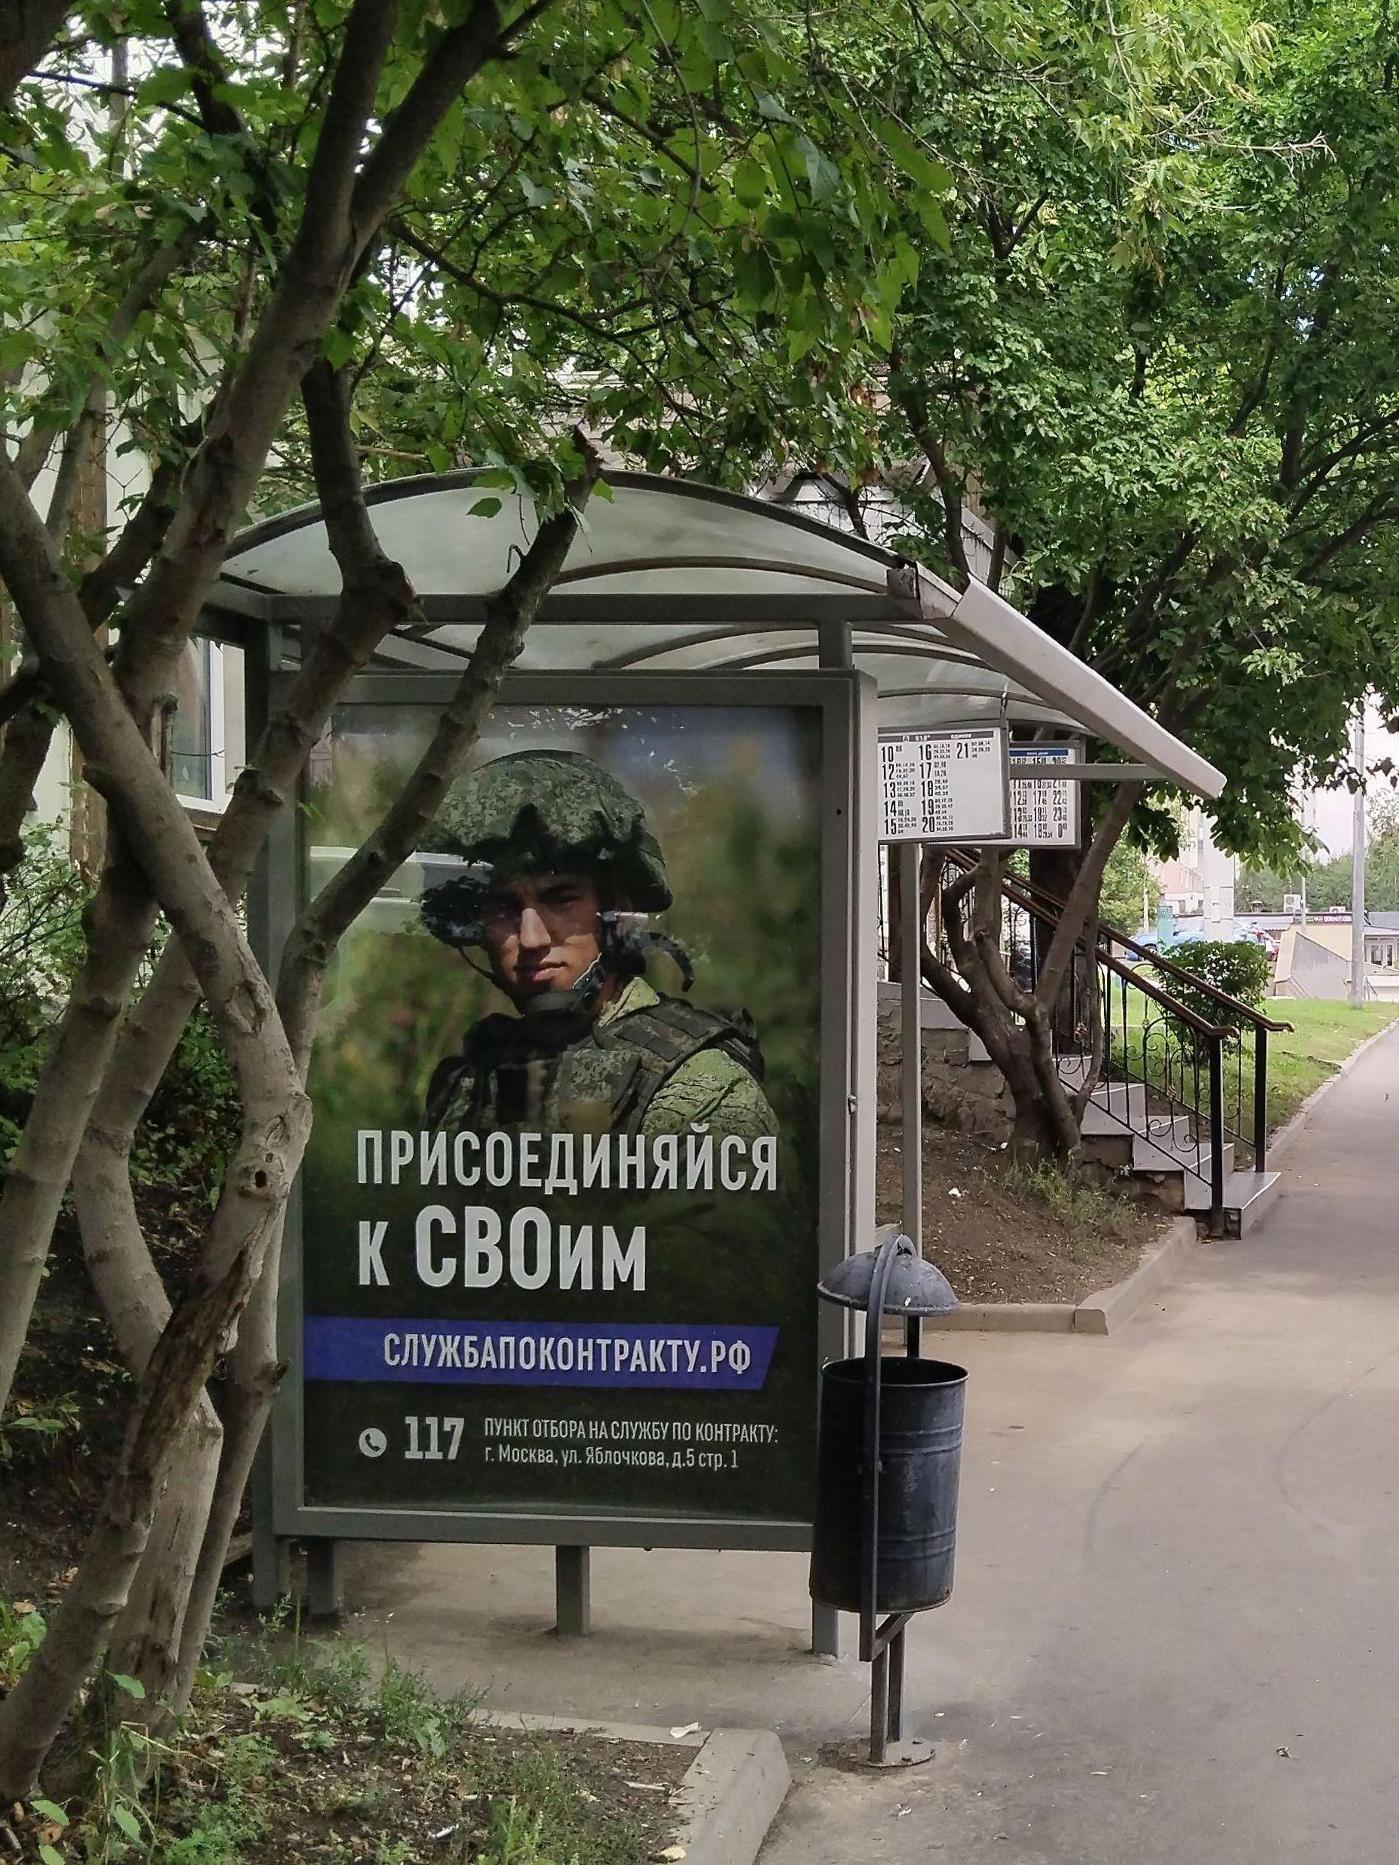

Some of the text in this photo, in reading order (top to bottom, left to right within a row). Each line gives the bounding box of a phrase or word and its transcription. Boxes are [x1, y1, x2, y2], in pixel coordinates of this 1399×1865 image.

[881, 746, 894, 762] 10
[919, 744, 932, 760] 16
[957, 742, 969, 759] 21
[882, 763, 895, 780] 12
[919, 762, 932, 779] 17
[883, 782, 896, 798] 13
[921, 781, 934, 797] 18
[884, 800, 897, 817] 14
[921, 799, 934, 815] 19
[884, 818, 897, 835] 15
[922, 816, 935, 833] 20
[357, 1122, 777, 1195] ПРИСОЕДИНЯЙСЯ
[383, 1332, 751, 1374] СЛУЖБАПОКОНТРАКТУ.РФ
[404, 1416, 465, 1460] 117
[484, 1417, 780, 1444] ПУНКТ ОТБОРА НА СЛУЖБУ ПО КОНТРАКТУ:
[485, 1443, 739, 1472] г. Москва, ул. Яблочкова, д.5 стр. 1
